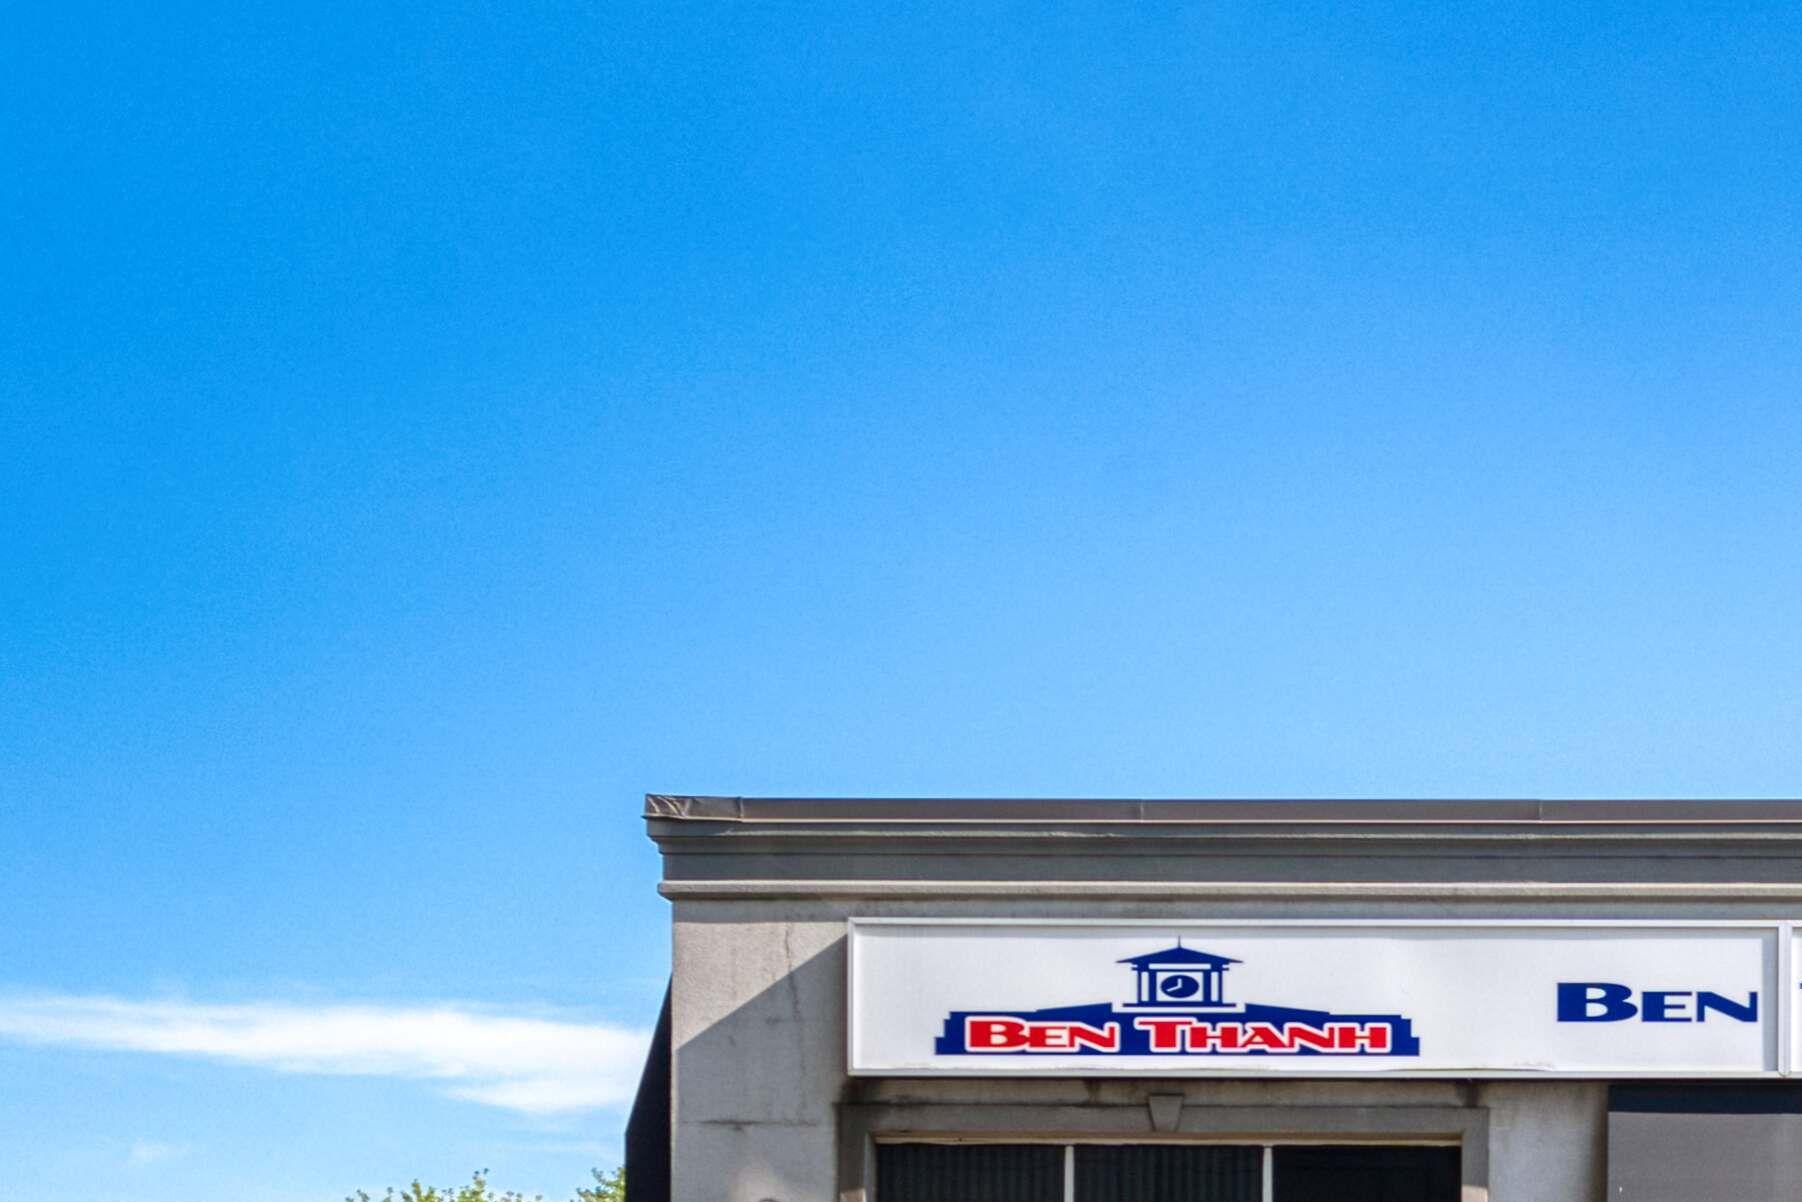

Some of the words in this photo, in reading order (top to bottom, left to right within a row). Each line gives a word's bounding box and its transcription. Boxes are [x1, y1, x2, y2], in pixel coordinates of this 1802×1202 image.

[1556, 981, 1758, 1023] BEN
[964, 1015, 1119, 1053] BEN
[1135, 1015, 1393, 1053] THANH
